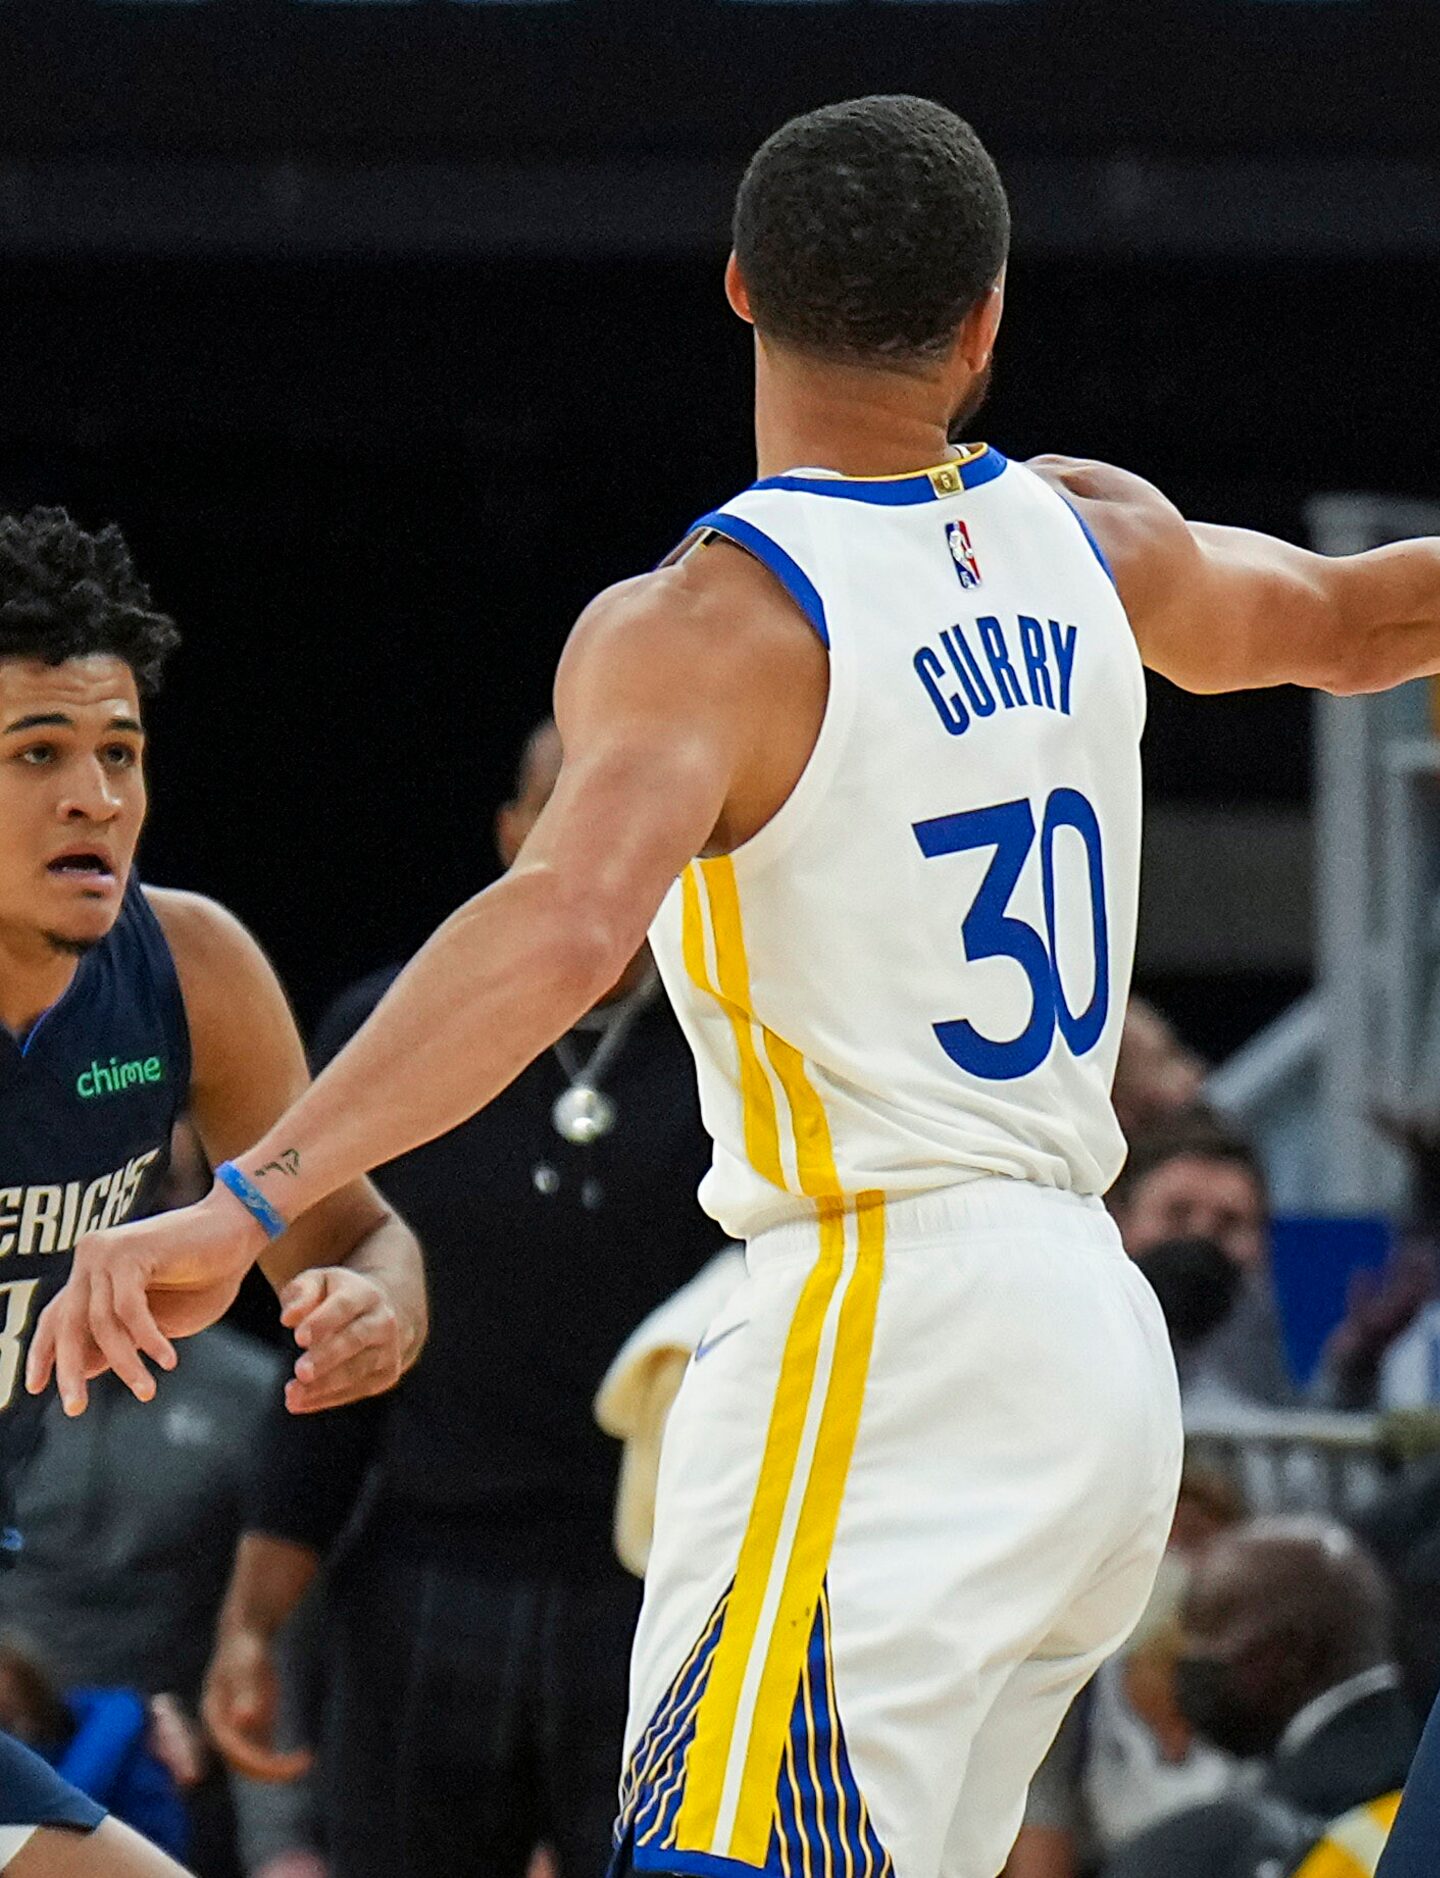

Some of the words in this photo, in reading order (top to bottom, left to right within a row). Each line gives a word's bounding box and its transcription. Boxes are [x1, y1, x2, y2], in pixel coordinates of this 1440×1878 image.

[913, 614, 1078, 736] CURRY
[911, 787, 1109, 1080] 30
[76, 1053, 162, 1099] chime
